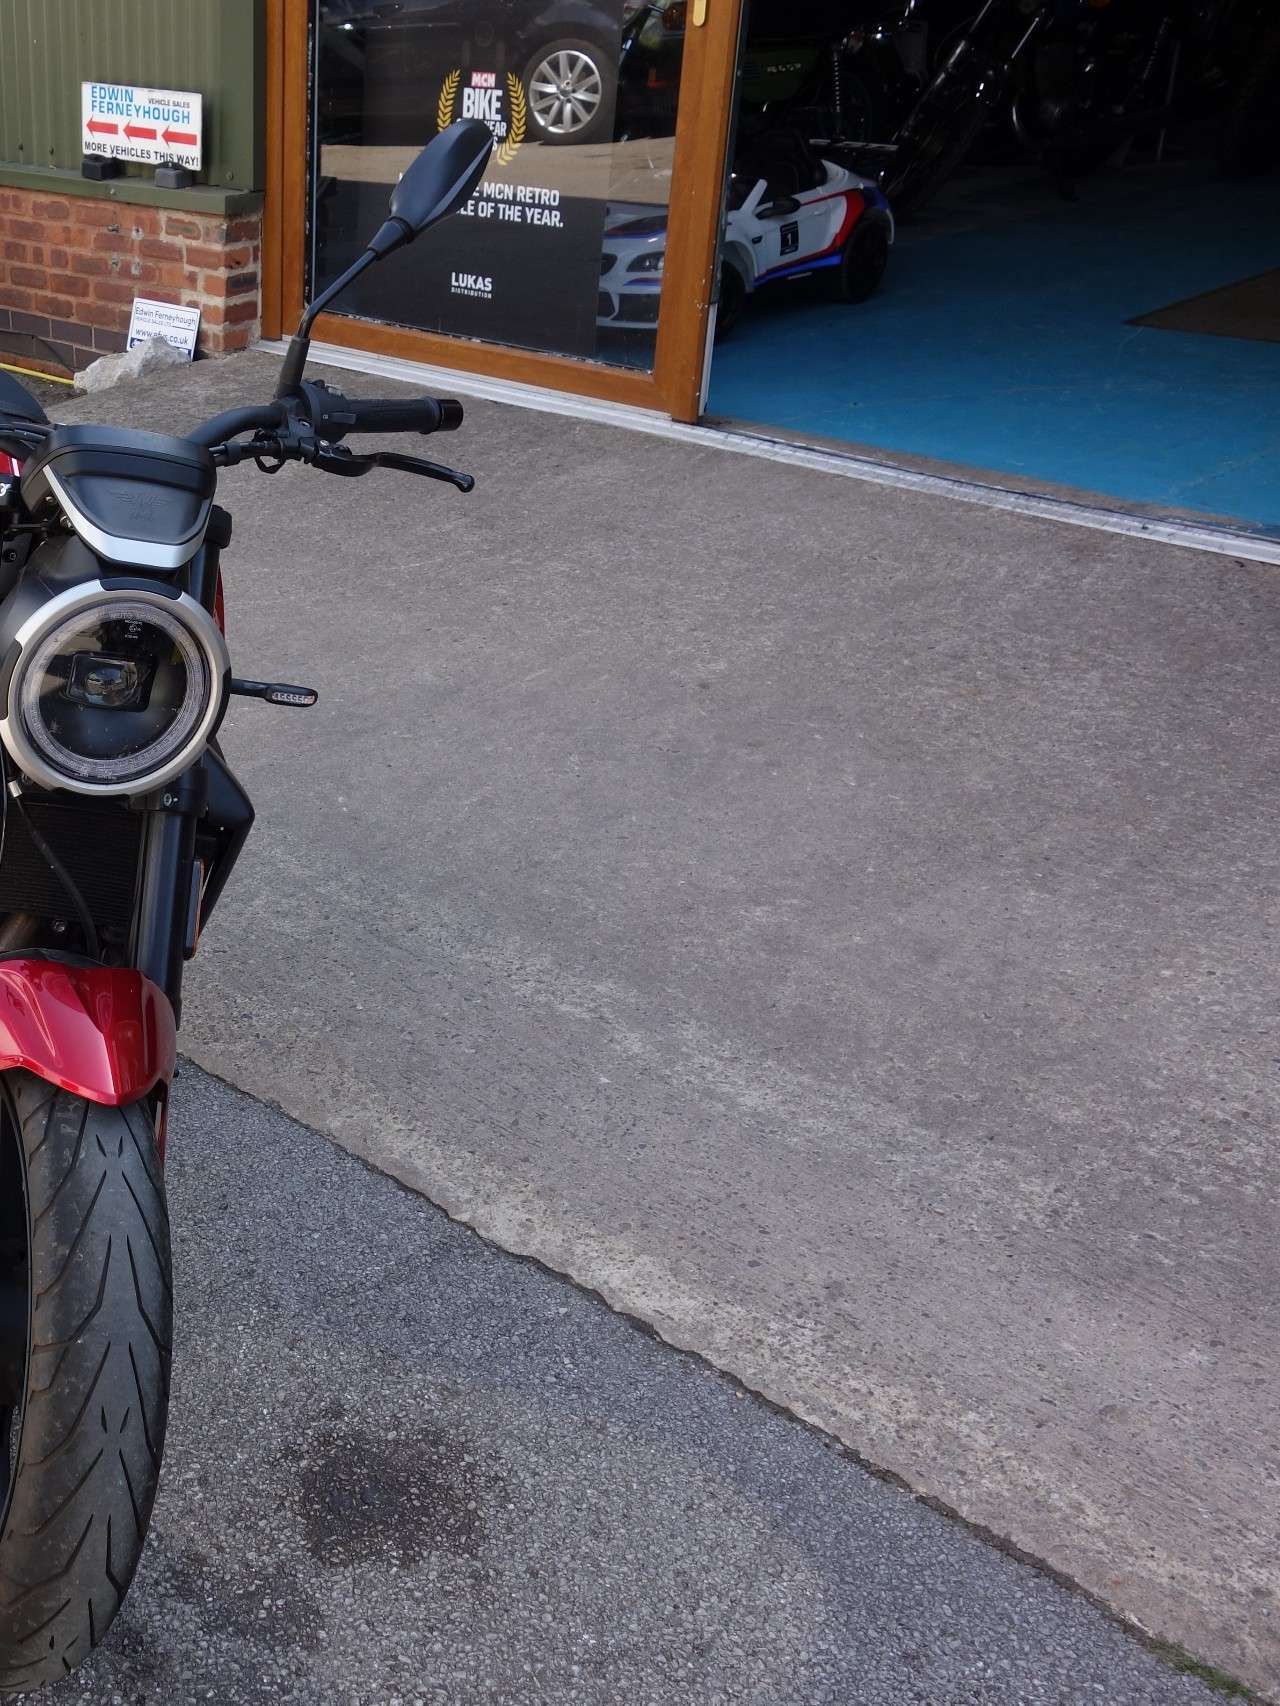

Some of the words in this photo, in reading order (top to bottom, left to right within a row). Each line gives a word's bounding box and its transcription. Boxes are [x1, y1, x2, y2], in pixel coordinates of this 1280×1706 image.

[471, 71, 496, 88] MCN
[91, 85, 134, 103] EDWIN
[147, 97, 172, 106] VEHICLE
[172, 100, 191, 109] SALES
[462, 87, 503, 121] BIKE
[91, 99, 191, 125] FERNEYHOUGH
[84, 141, 108, 153] MORE
[109, 144, 152, 160] VEHICLES
[153, 151, 176, 163] THIS
[176, 154, 200, 167] WAY!
[483, 181, 514, 201] MCN
[516, 185, 561, 207] RETRO
[477, 201, 495, 218] OF
[497, 203, 523, 223] THE
[525, 206, 565, 228] YEAR.
[451, 271, 492, 292] LUKAS
[135, 306, 154, 318] Edwin
[155, 310, 197, 327] Ferneyhough
